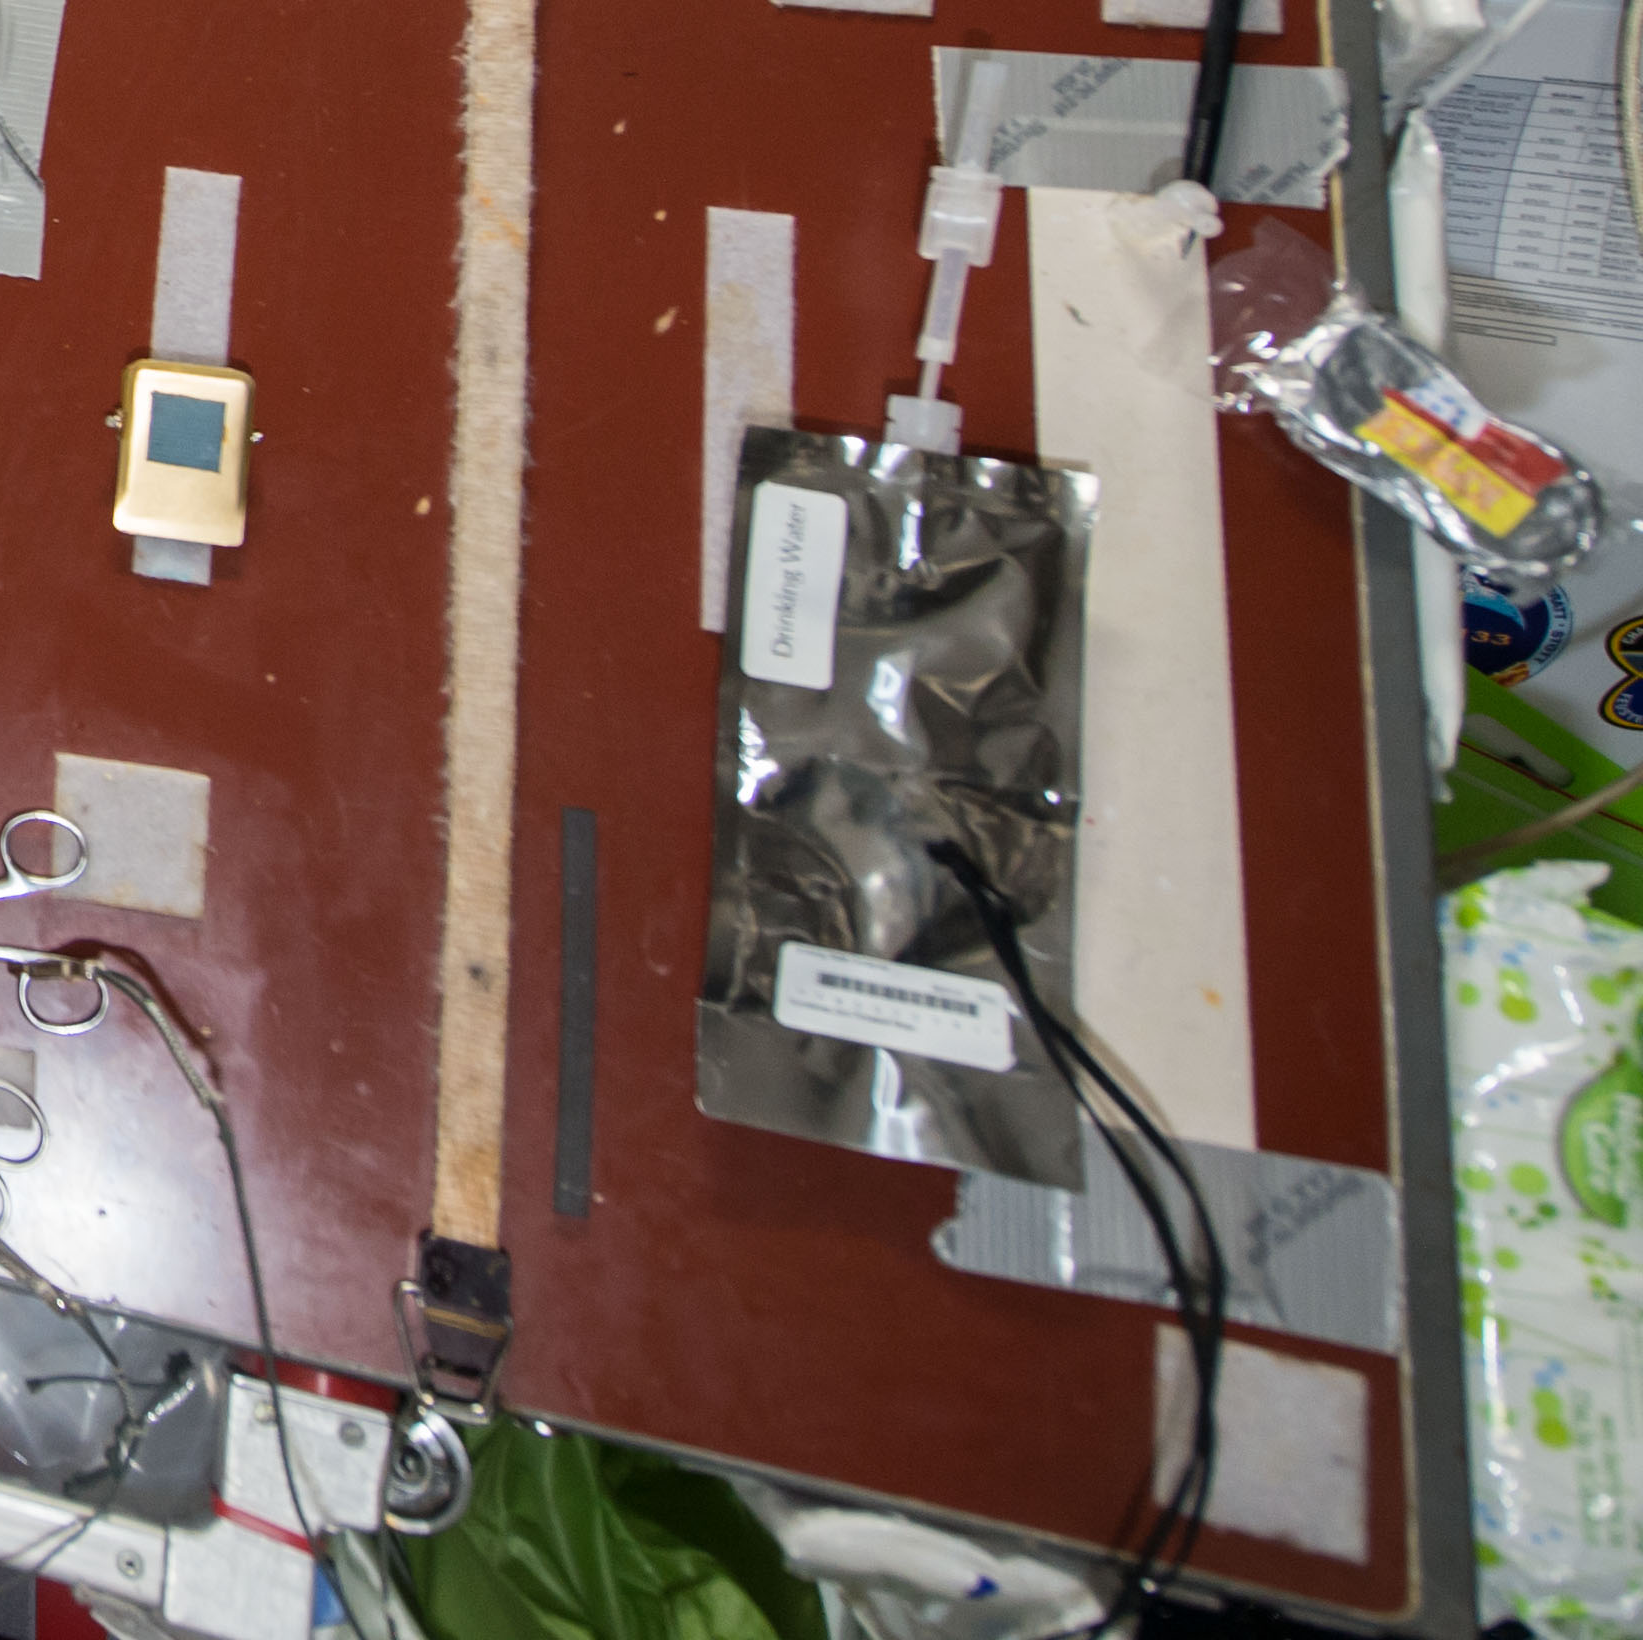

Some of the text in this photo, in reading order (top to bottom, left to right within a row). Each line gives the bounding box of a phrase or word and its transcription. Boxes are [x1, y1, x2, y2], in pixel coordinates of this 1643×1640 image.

[769, 502, 808, 660] Drinking Water
[1533, 630, 1565, 665] STOTT
